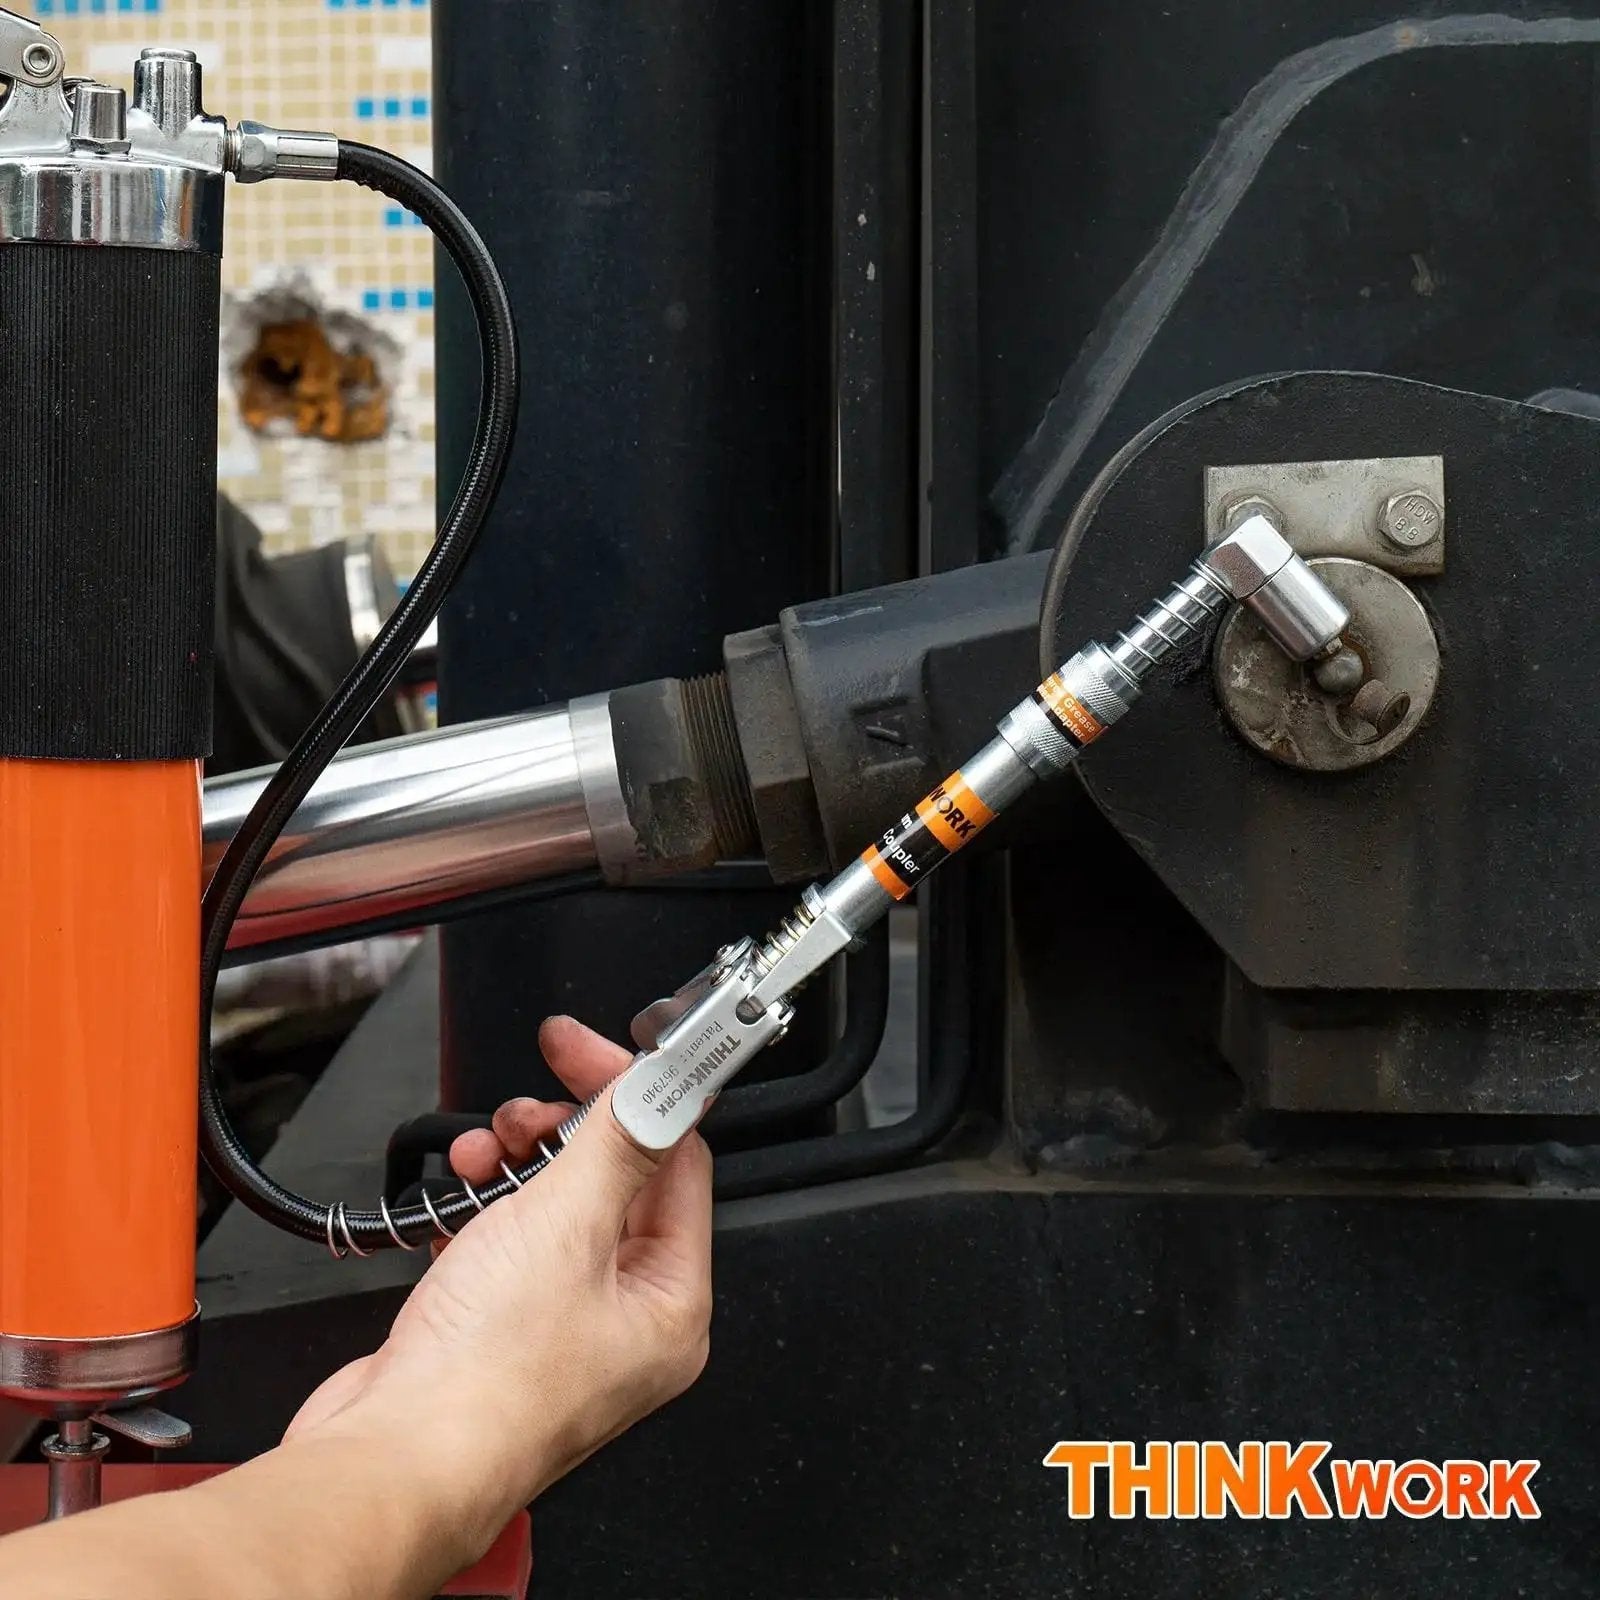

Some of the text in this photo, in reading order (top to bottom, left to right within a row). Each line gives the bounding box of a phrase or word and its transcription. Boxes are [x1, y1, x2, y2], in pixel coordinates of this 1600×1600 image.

[1404, 497, 1436, 525] HDW
[1064, 697, 1096, 733] Grease
[883, 828, 920, 873] Coupler
[642, 1065, 680, 1105] 967940
